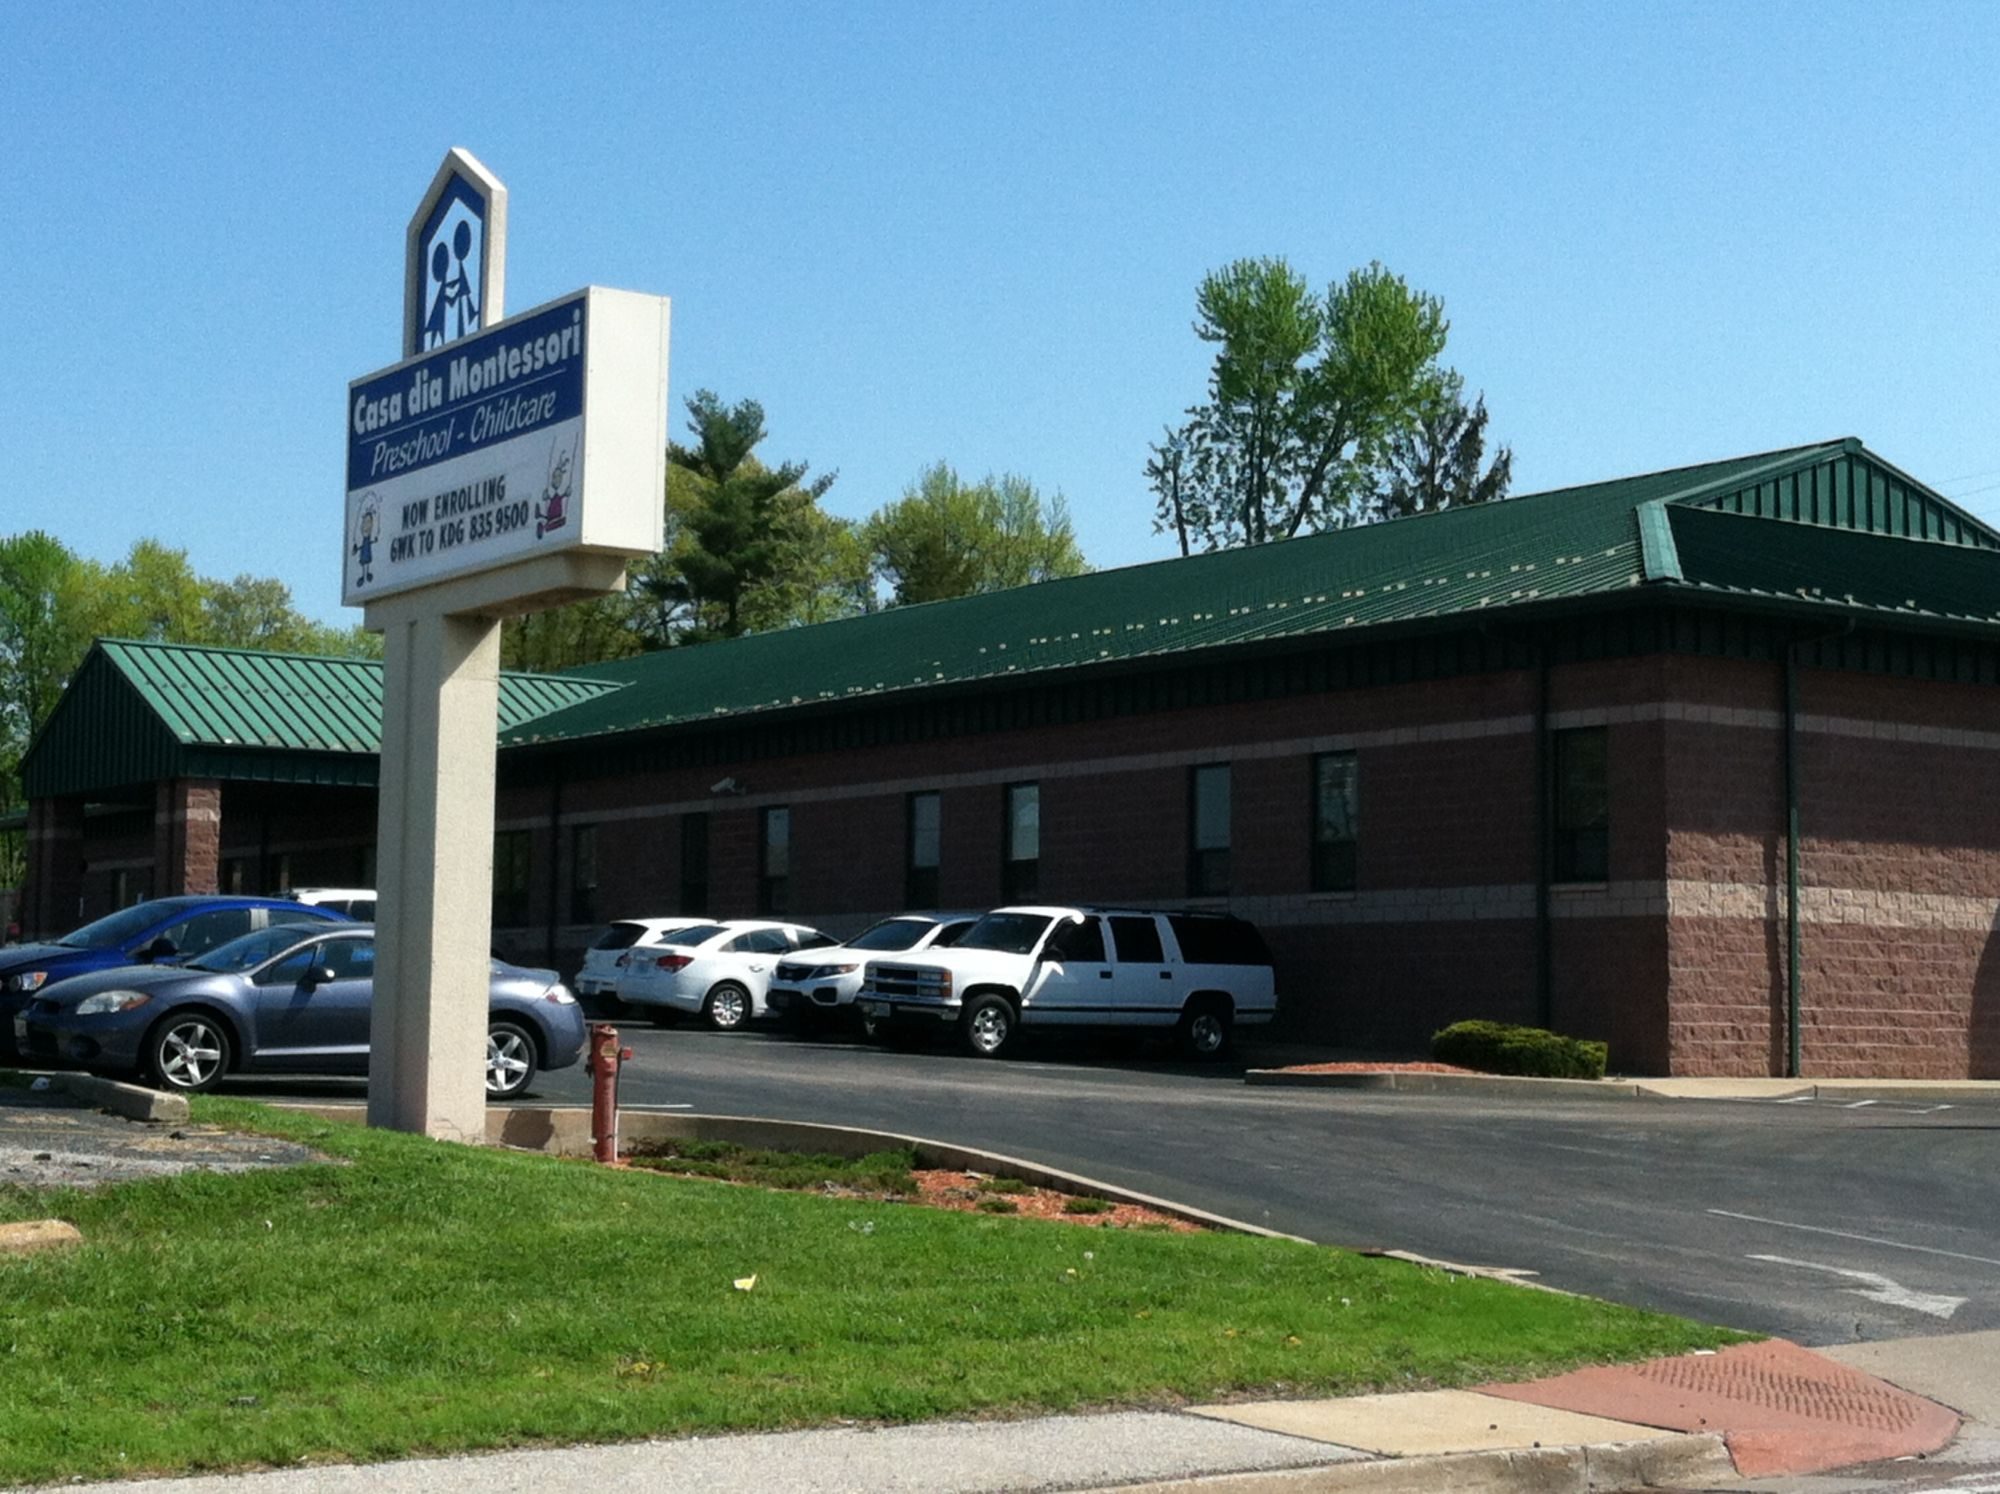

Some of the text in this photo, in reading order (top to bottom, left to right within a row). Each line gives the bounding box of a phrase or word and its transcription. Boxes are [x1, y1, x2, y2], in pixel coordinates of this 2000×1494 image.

[355, 308, 580, 434] Casa dia Montessori
[371, 419, 455, 476] Preschool
[471, 390, 557, 443] Childcare
[390, 501, 529, 562] 6WK TO KDG 835 9500
[402, 475, 506, 529] NOW ENROLLING
